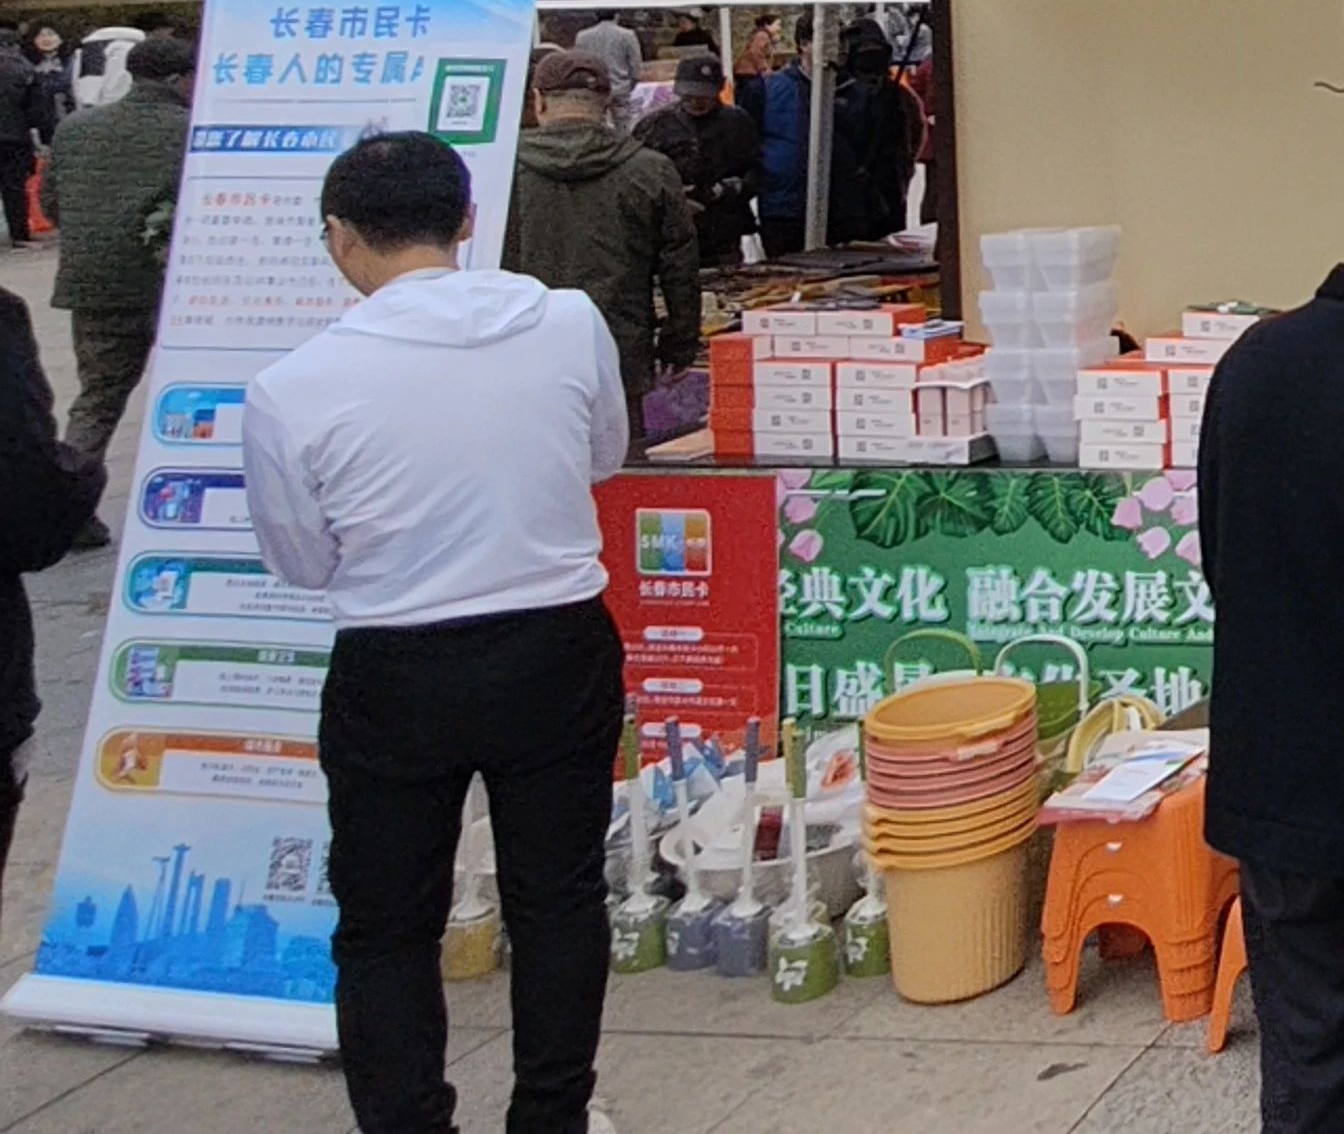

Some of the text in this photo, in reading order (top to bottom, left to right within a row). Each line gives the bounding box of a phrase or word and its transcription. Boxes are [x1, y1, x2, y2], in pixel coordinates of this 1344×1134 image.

[270, 4, 432, 40] 长春市民卡
[966, 565, 1214, 624] 融合发展文
[1070, 626, 1124, 642] Develop
[1129, 627, 1181, 640] Culture
[1187, 628, 1213, 640] And
